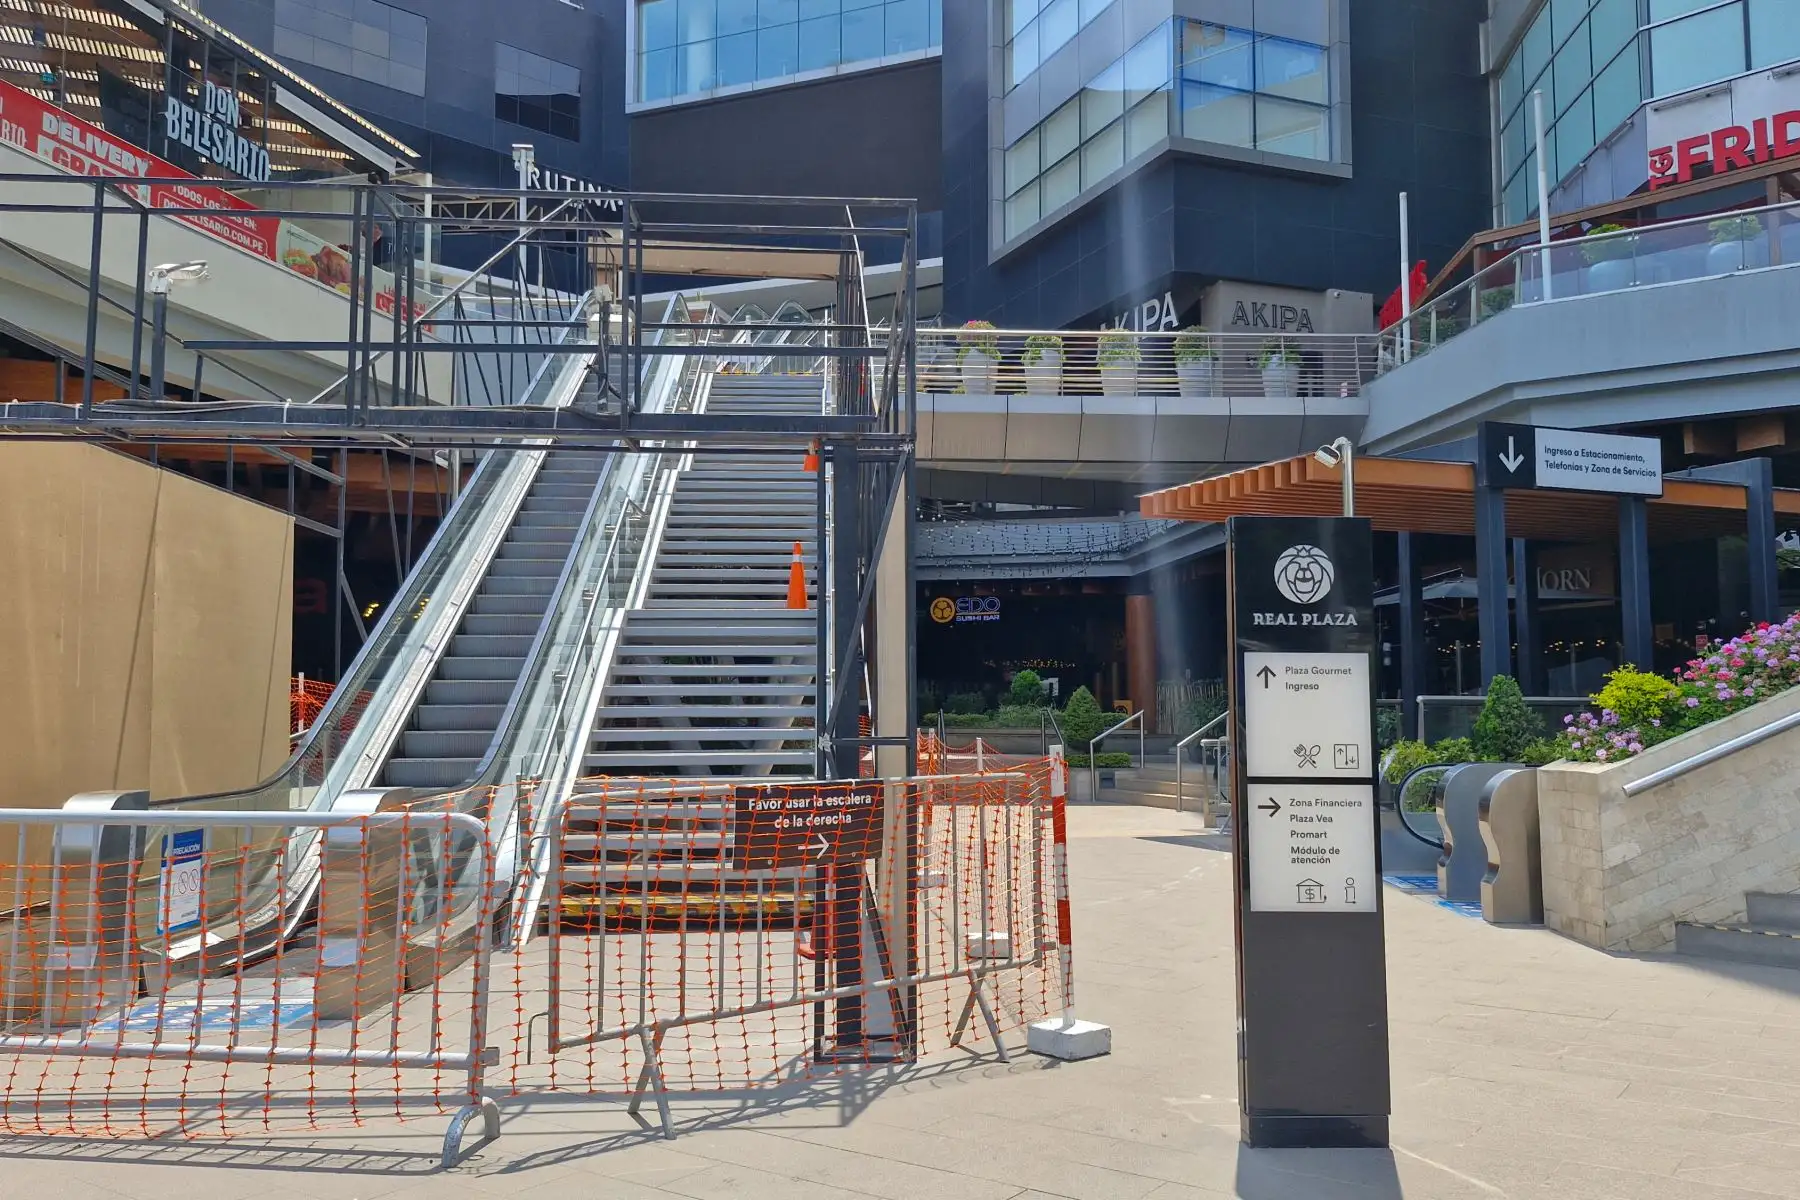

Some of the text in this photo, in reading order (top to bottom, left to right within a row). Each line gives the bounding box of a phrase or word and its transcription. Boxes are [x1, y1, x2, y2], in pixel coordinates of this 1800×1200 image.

[205, 80, 241, 129] DON
[42, 111, 149, 178] DELIVERY
[166, 95, 271, 182] BELISARIO
[51, 145, 139, 198] GRAS
[163, 198, 264, 253] DOELISARIO.COM.PE
[1231, 300, 1315, 334] AKIPA
[1544, 445, 1573, 458] Ingreso
[1580, 448, 1646, 464] Estacionamiento,
[1591, 463, 1611, 474] Zona
[1612, 465, 1622, 475] de
[1623, 466, 1657, 478] Servicios
[1536, 566, 1592, 591] ORN
[955, 596, 1001, 613] EDO
[1253, 612, 1358, 626] REAL PLAZA
[1285, 666, 1352, 675] Plaza Gourmet
[1285, 681, 1320, 692] Ingreso
[748, 792, 872, 811] Favor usar la escalera
[1289, 798, 1362, 807] Zona Financiera
[774, 812, 852, 829] de la derecha
[1290, 814, 1334, 823] Plaza Vea
[1290, 830, 1328, 839] Promart
[1290, 846, 1340, 855] Módulo de
[1291, 855, 1331, 864] atención
